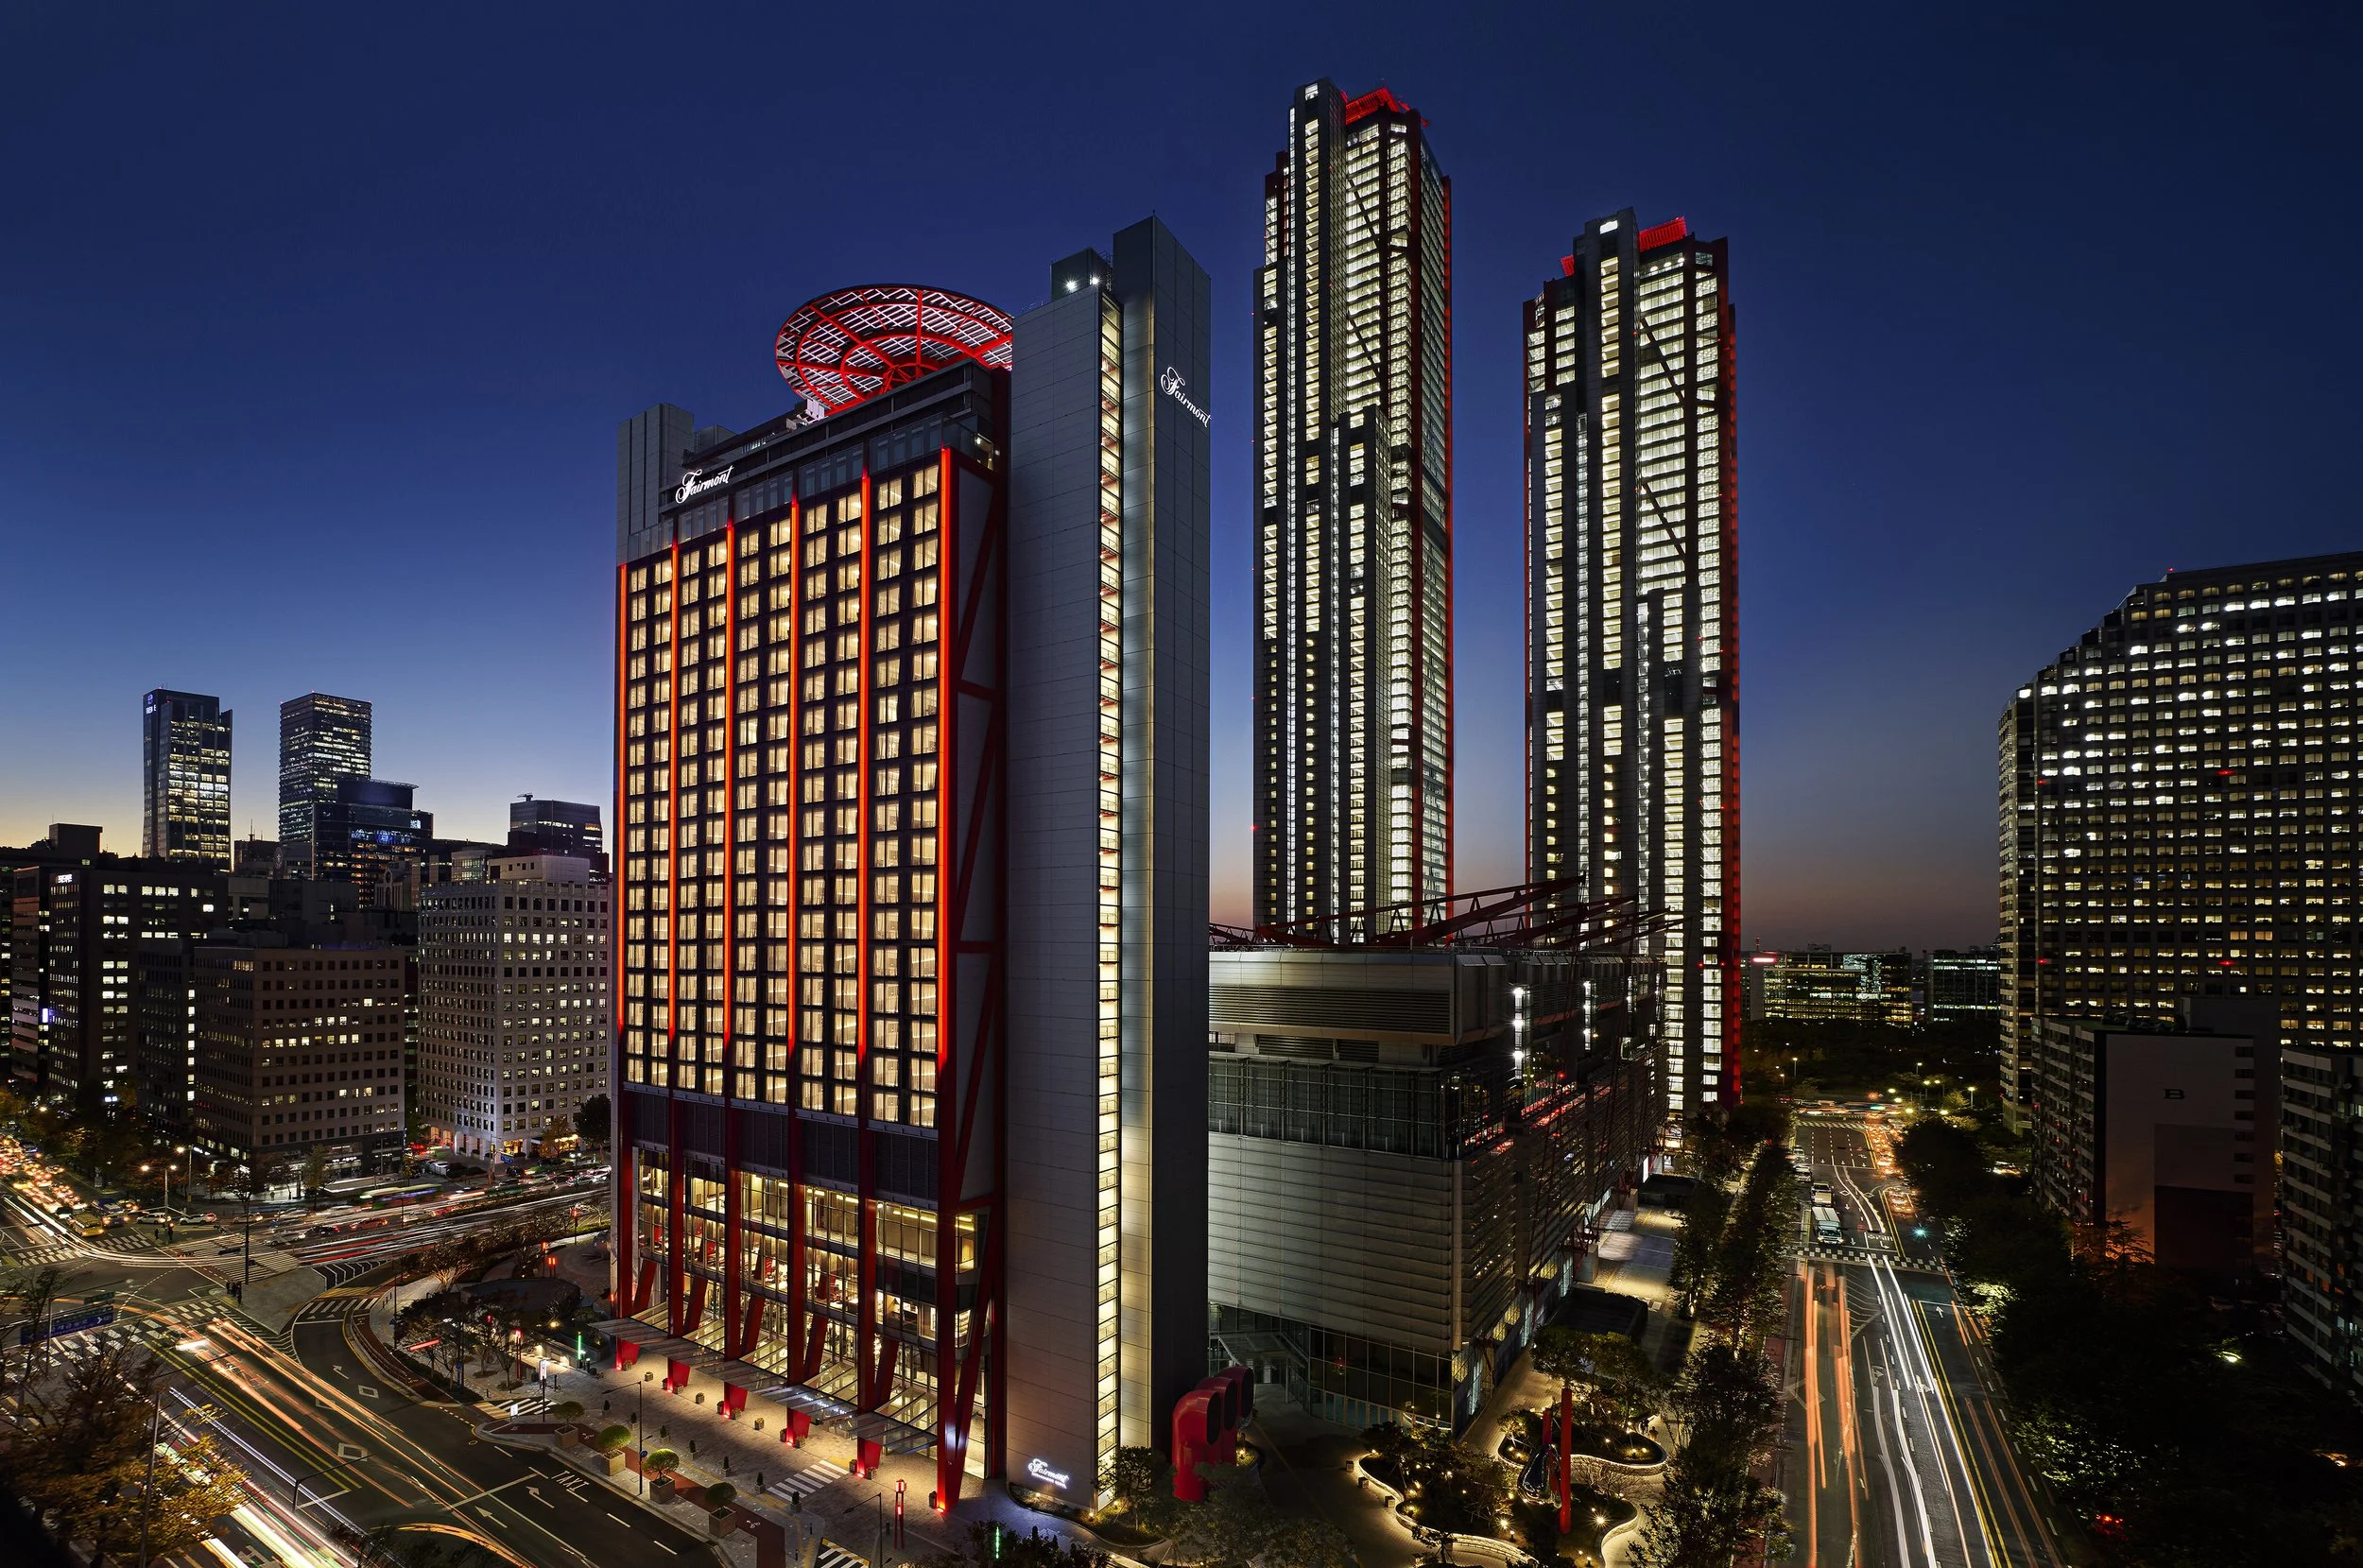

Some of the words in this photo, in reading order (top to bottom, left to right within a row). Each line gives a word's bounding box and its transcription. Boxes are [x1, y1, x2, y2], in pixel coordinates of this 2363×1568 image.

[1160, 366, 1212, 428] Fairmont
[675, 464, 735, 504] Fairmont
[2163, 1088, 2185, 1099] B
[551, 1470, 590, 1492] TAXI
[1027, 1457, 1070, 1484] Fairmont
